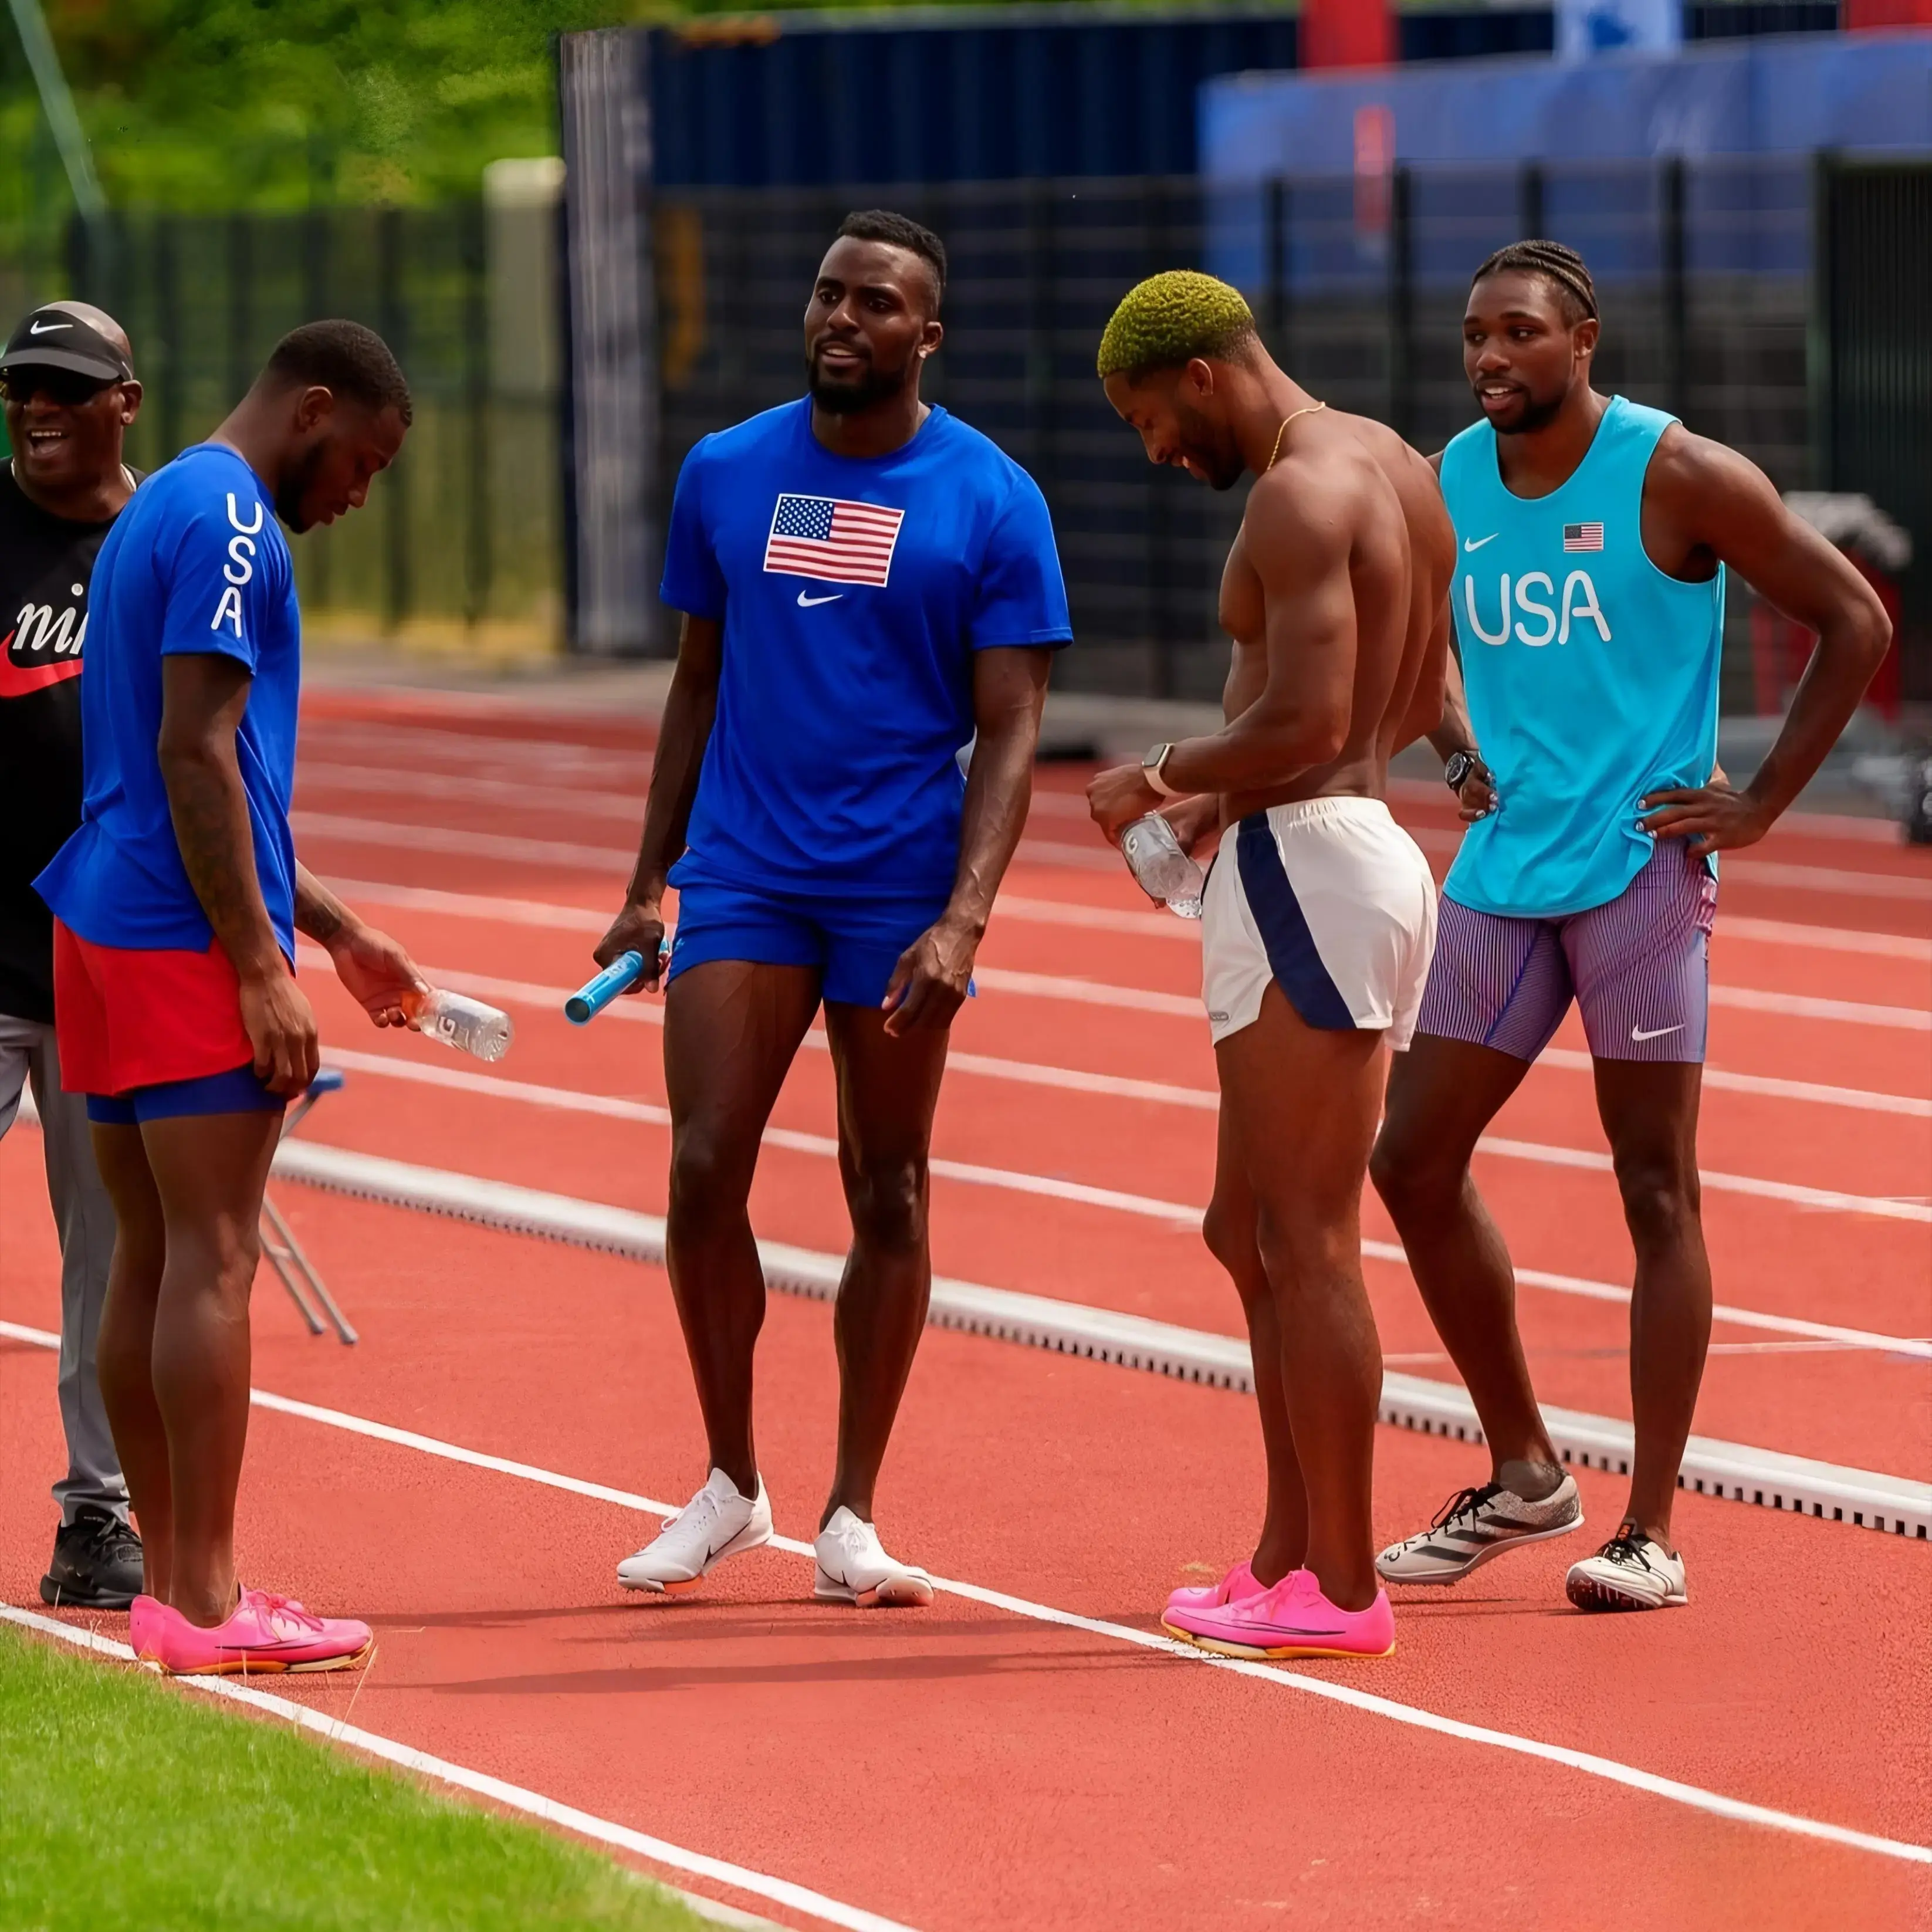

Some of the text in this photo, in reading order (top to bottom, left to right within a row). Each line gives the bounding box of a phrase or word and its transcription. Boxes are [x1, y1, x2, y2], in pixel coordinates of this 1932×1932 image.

[211, 492, 263, 638] USA
[1465, 570, 1612, 647] USA
[439, 1016, 456, 1038] G
